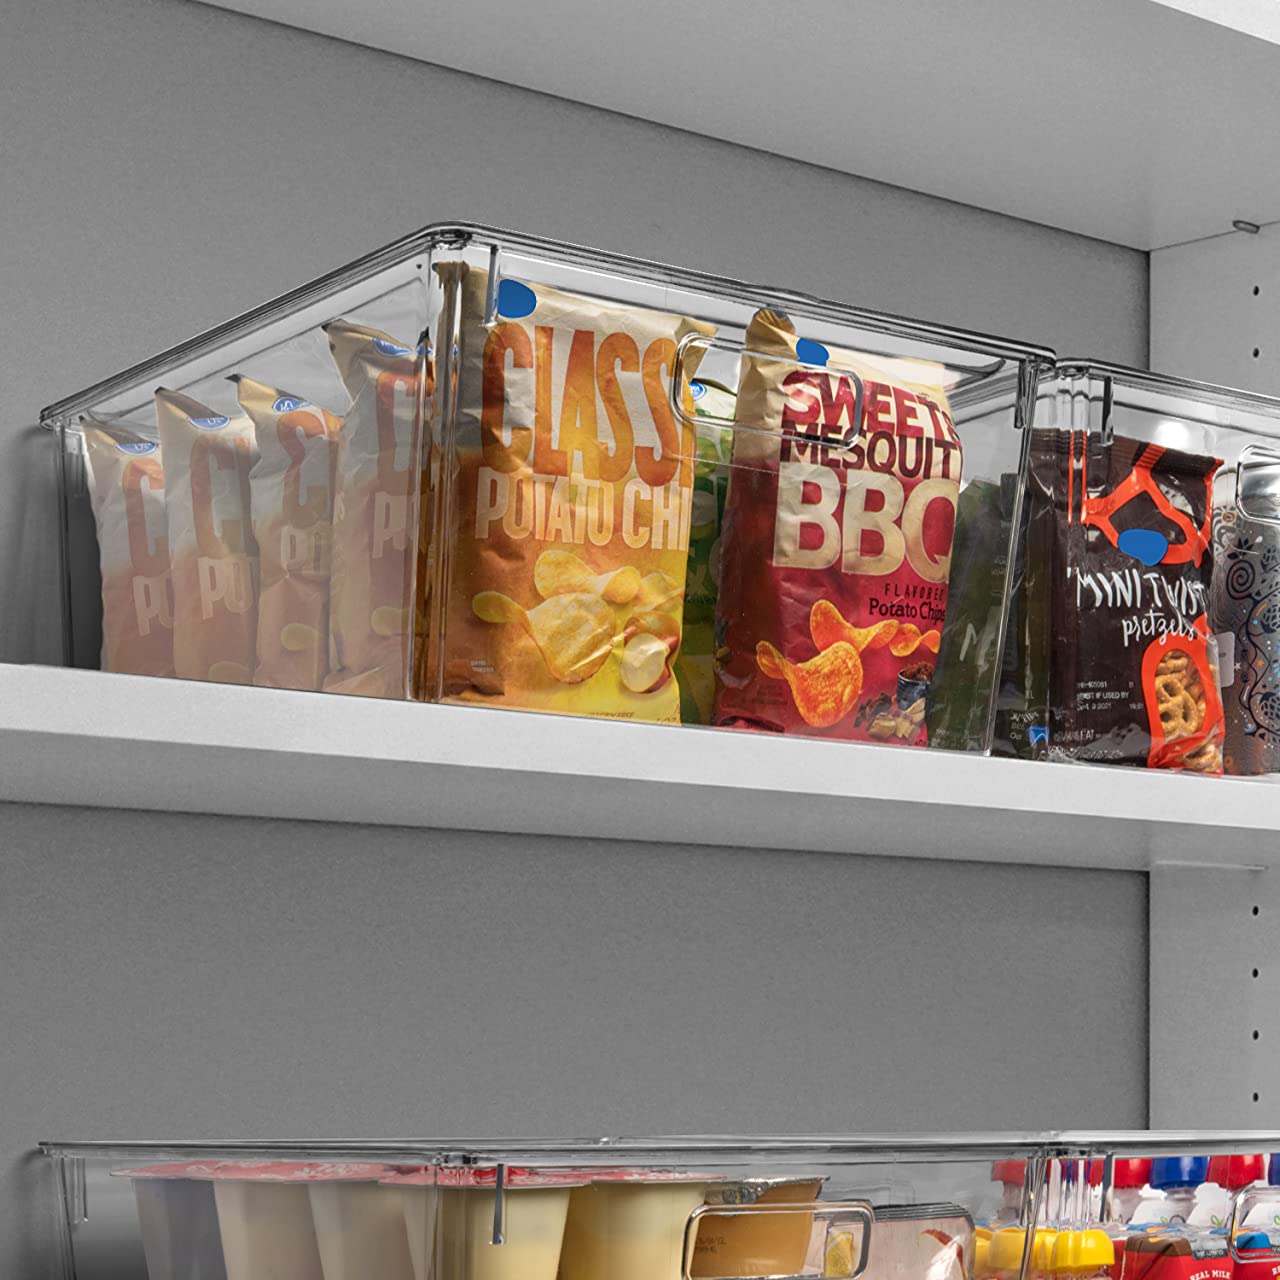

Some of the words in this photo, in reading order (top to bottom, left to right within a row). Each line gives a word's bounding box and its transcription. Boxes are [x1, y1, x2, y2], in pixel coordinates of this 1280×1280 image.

[782, 370, 950, 443] SWEET
[475, 466, 615, 546] POTATO
[773, 463, 960, 585] BBQ
[1067, 567, 1142, 608] MINI
[869, 598, 918, 619] Potato
[920, 602, 946, 625] Chips
[1122, 608, 1194, 648] pretzels
[1212, 1269, 1231, 1280] MILK
